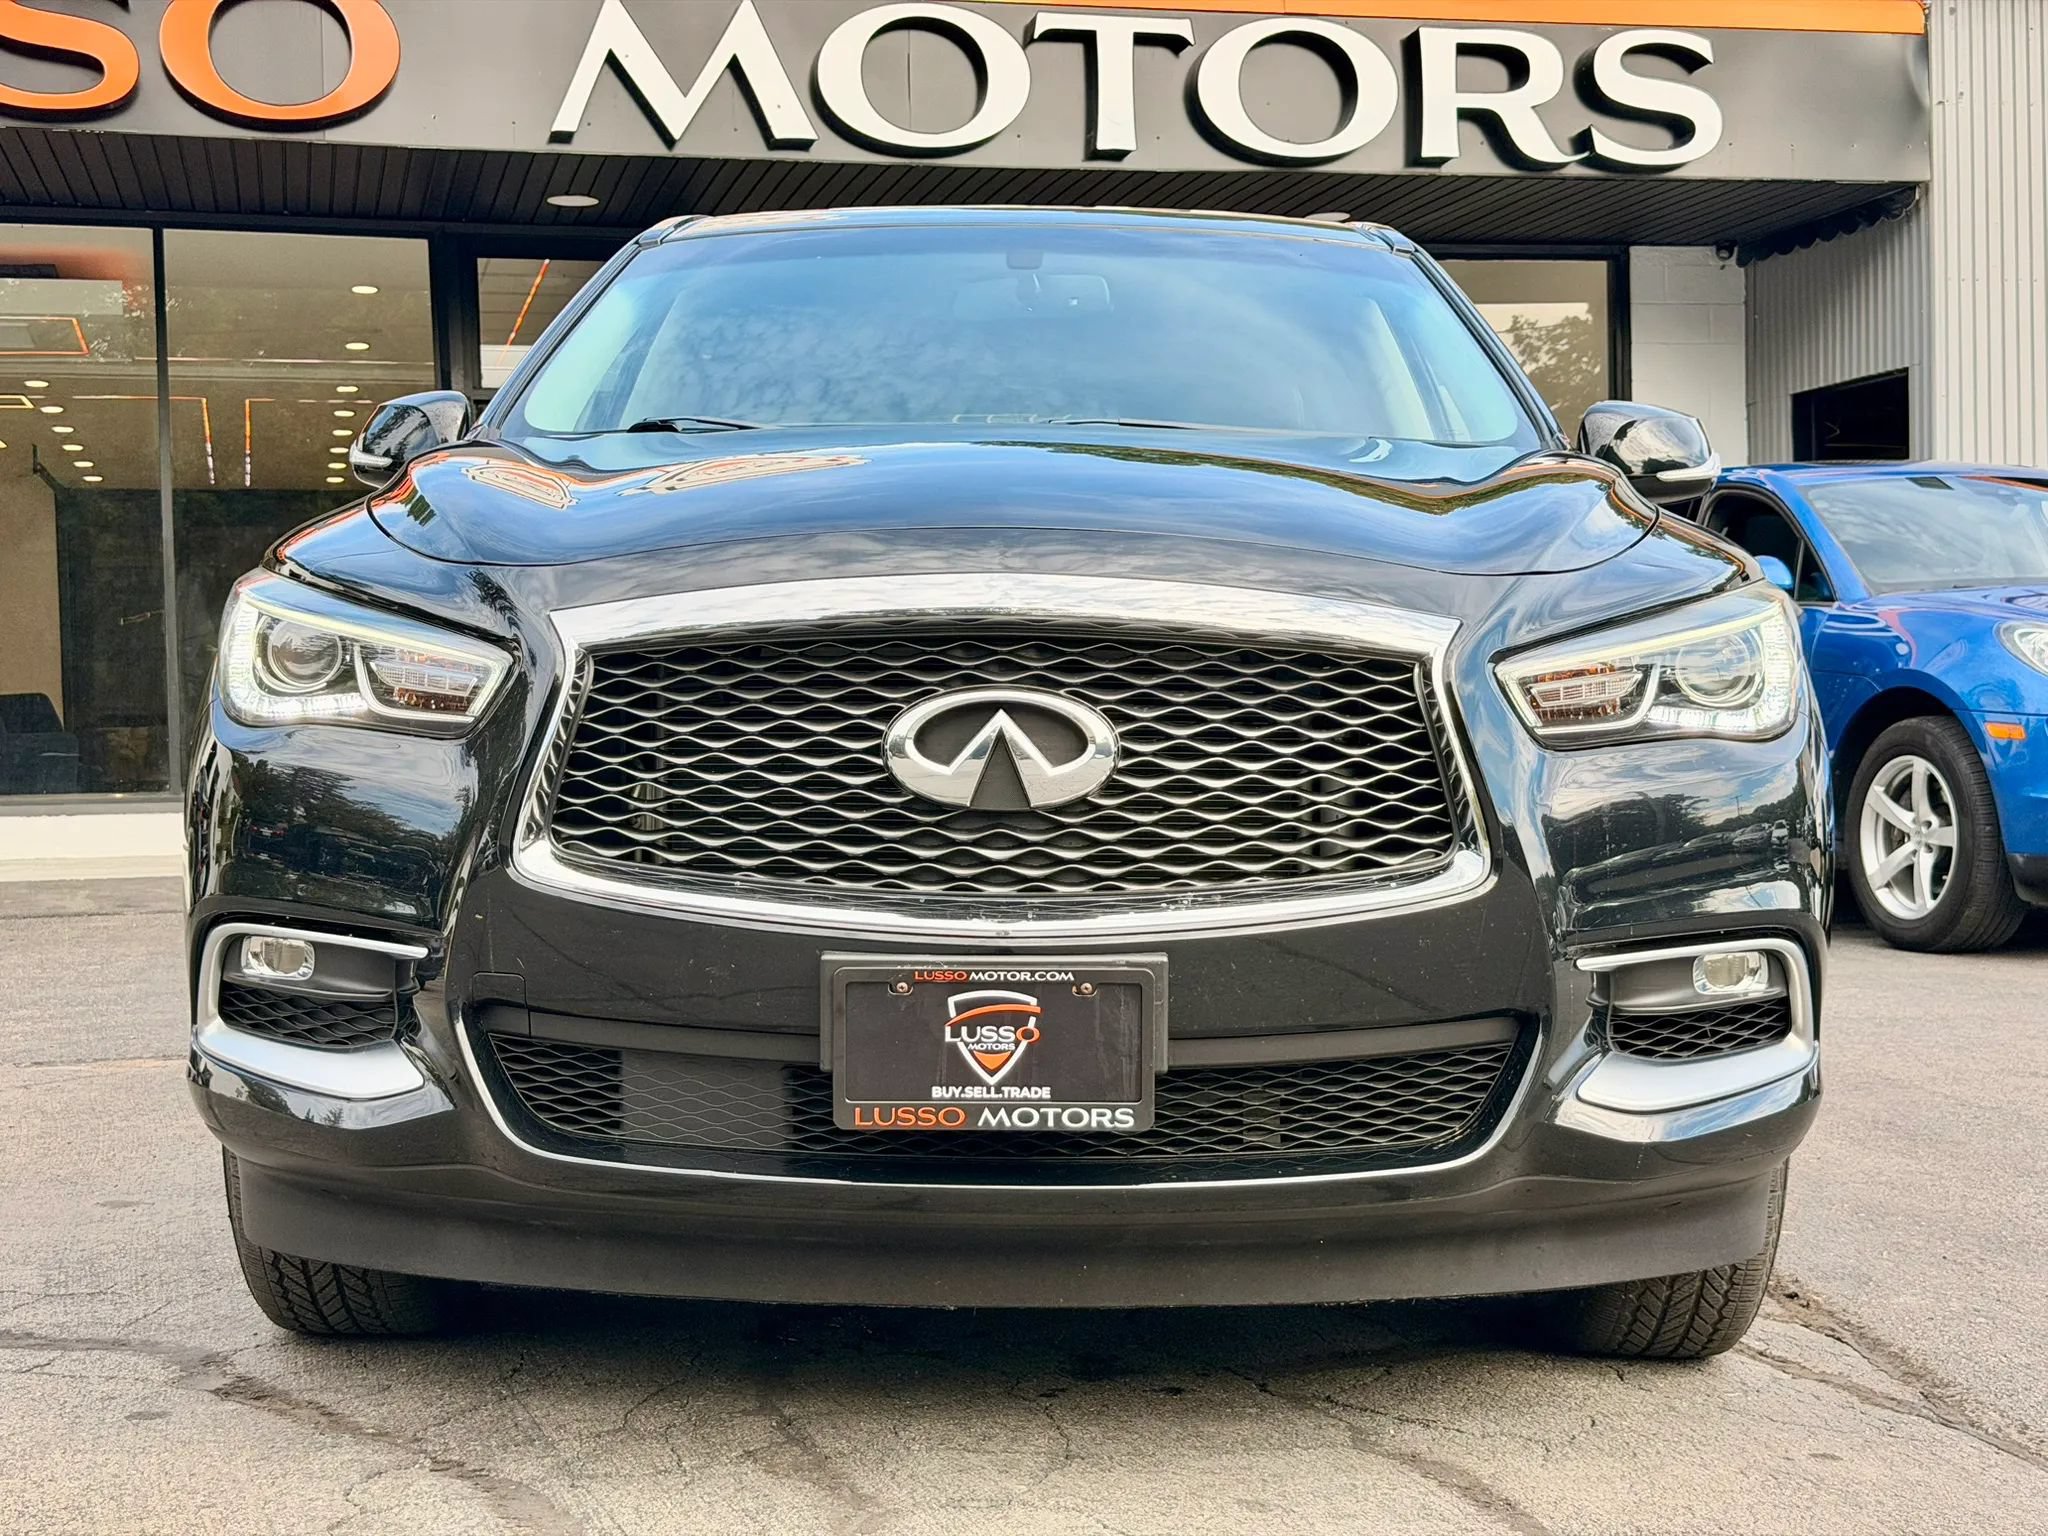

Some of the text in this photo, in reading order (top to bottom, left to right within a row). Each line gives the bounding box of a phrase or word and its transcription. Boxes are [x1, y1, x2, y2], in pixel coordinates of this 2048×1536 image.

[551, 0, 1723, 168] MOTORS
[945, 1025, 1040, 1043] LUSSO
[968, 1043, 1016, 1051] MOTORS
[854, 1107, 1135, 1128] LUSSO MOTORS
